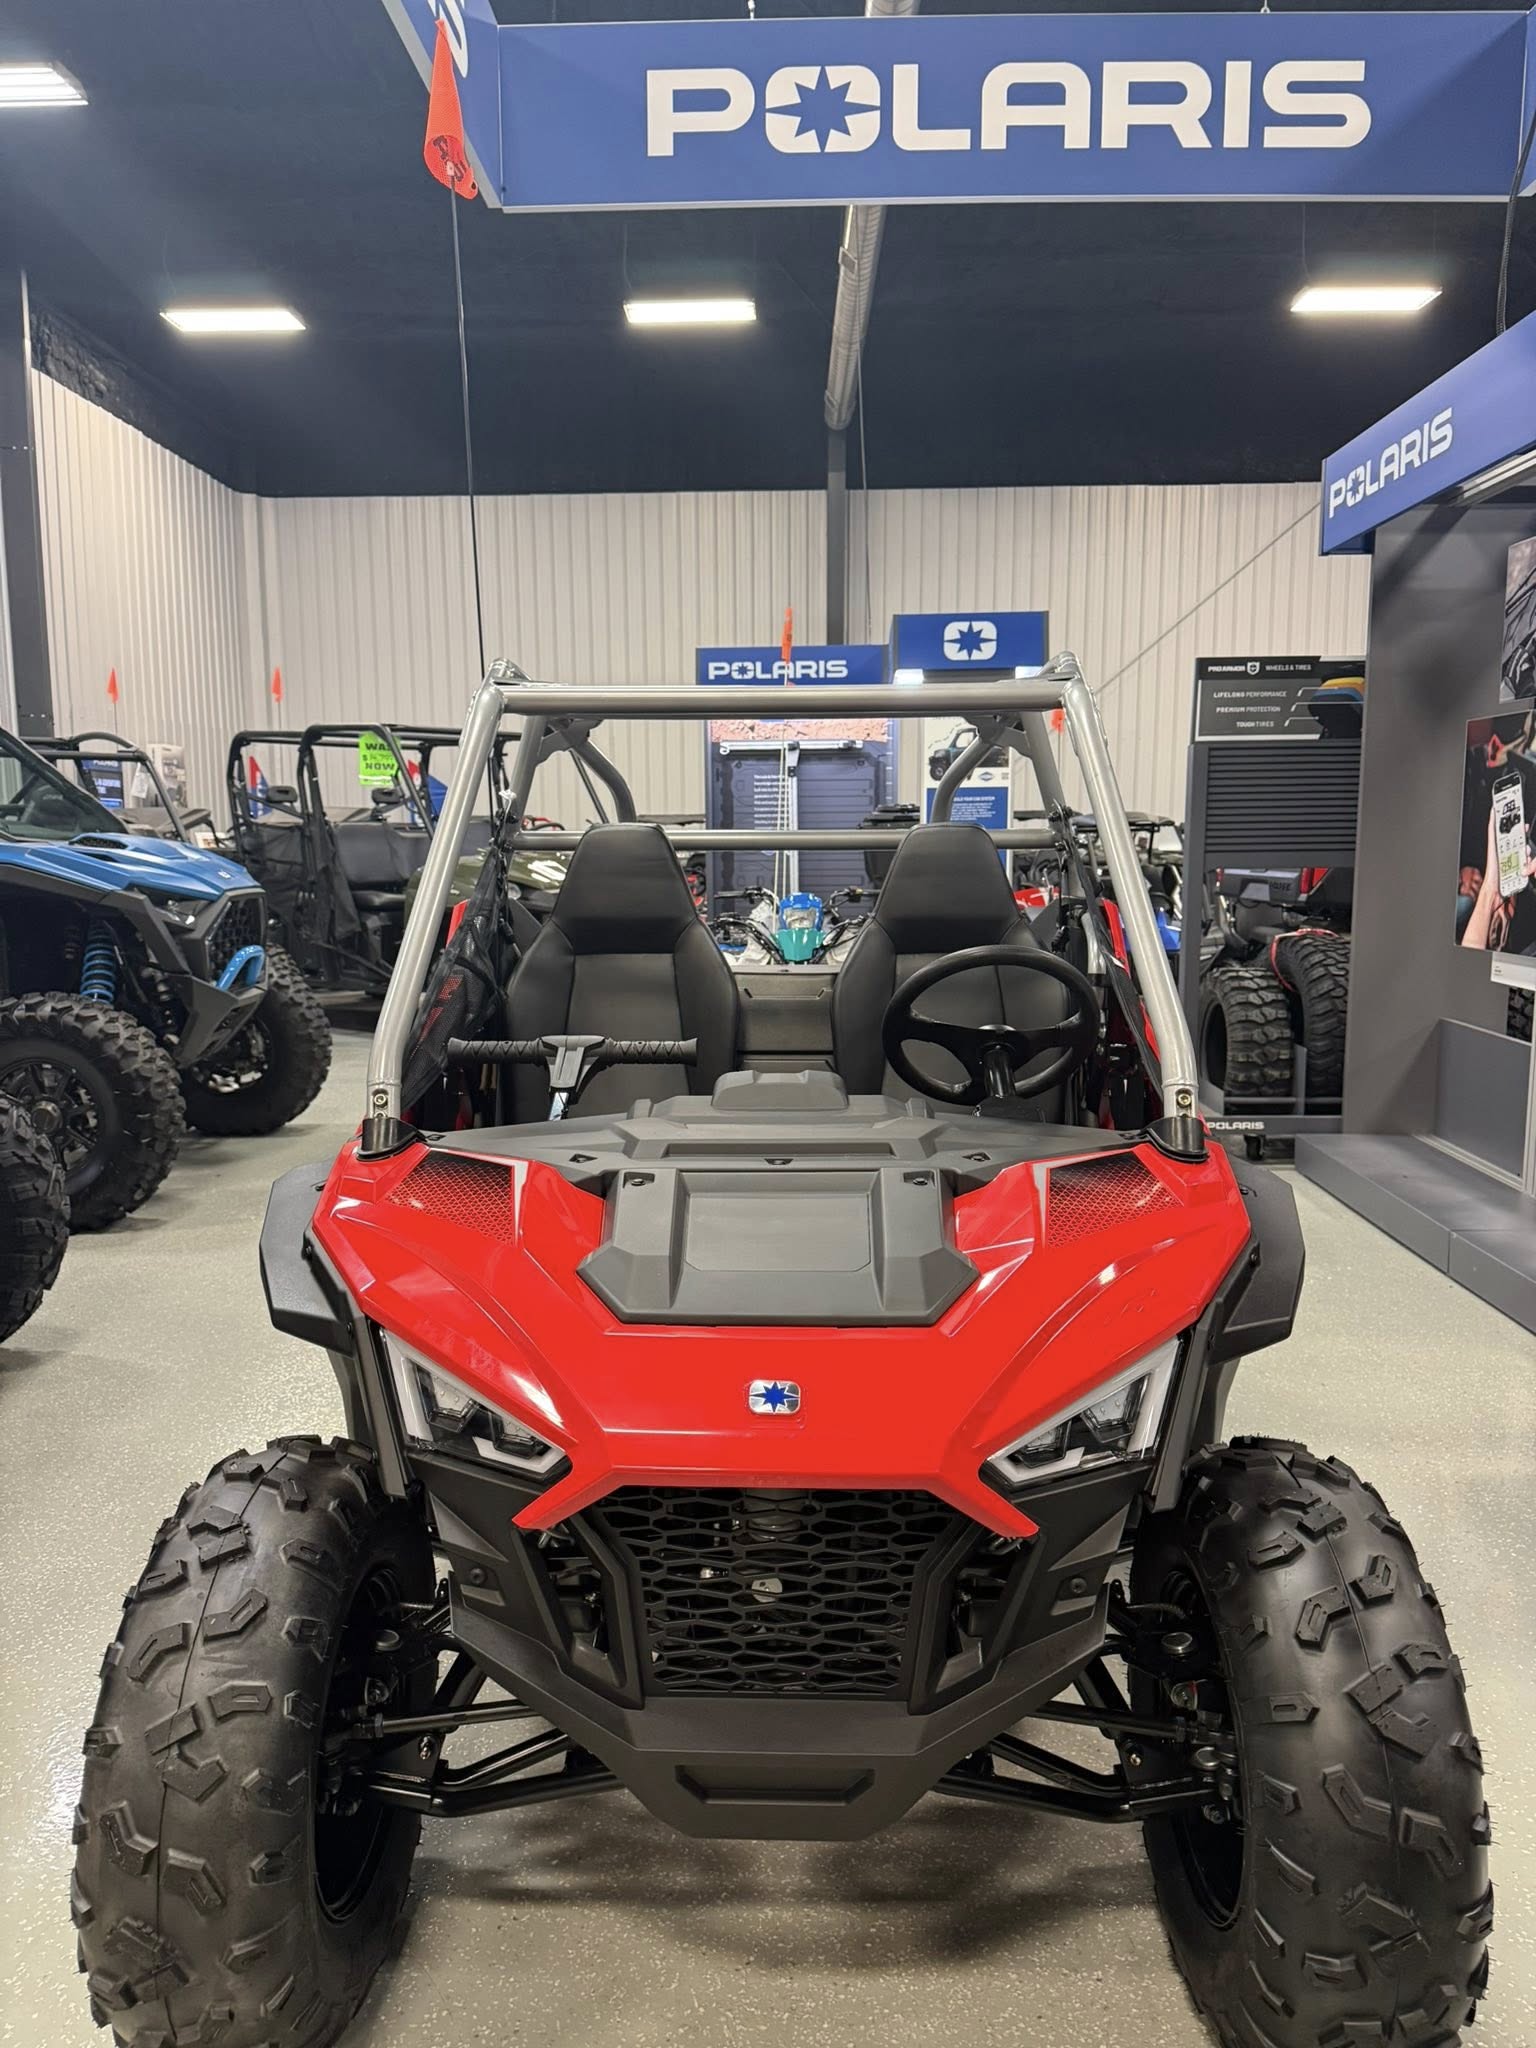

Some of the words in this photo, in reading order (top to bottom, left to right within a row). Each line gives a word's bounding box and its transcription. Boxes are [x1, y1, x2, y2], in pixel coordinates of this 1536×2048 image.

[646, 60, 1372, 157] POLARIS
[1329, 407, 1454, 518] POLARIS
[708, 660, 848, 680] POLARIS
[1207, 1121, 1265, 1130] POLARIS
